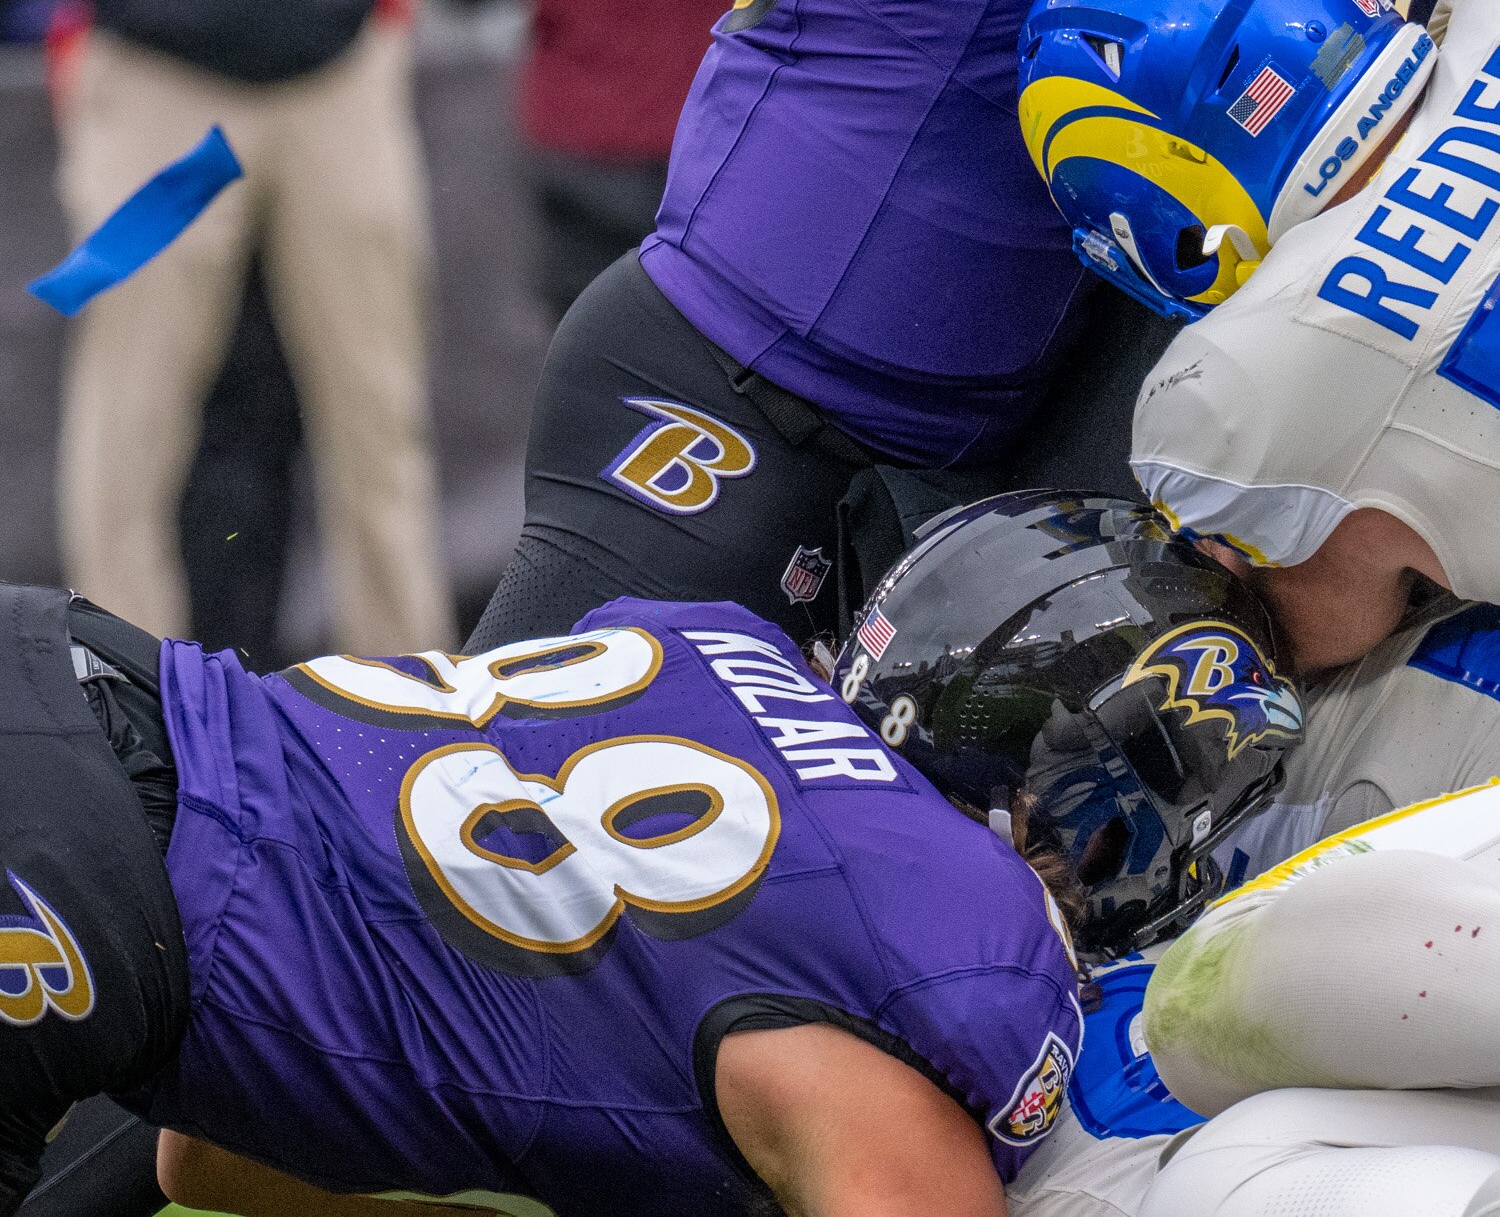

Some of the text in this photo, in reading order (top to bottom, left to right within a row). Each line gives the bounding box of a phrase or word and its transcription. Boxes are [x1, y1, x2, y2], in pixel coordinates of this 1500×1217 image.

[1303, 135, 1359, 198] LOS
[1356, 32, 1435, 141] ANGELES
[603, 397, 758, 515] B
[680, 630, 899, 783] KOLAR
